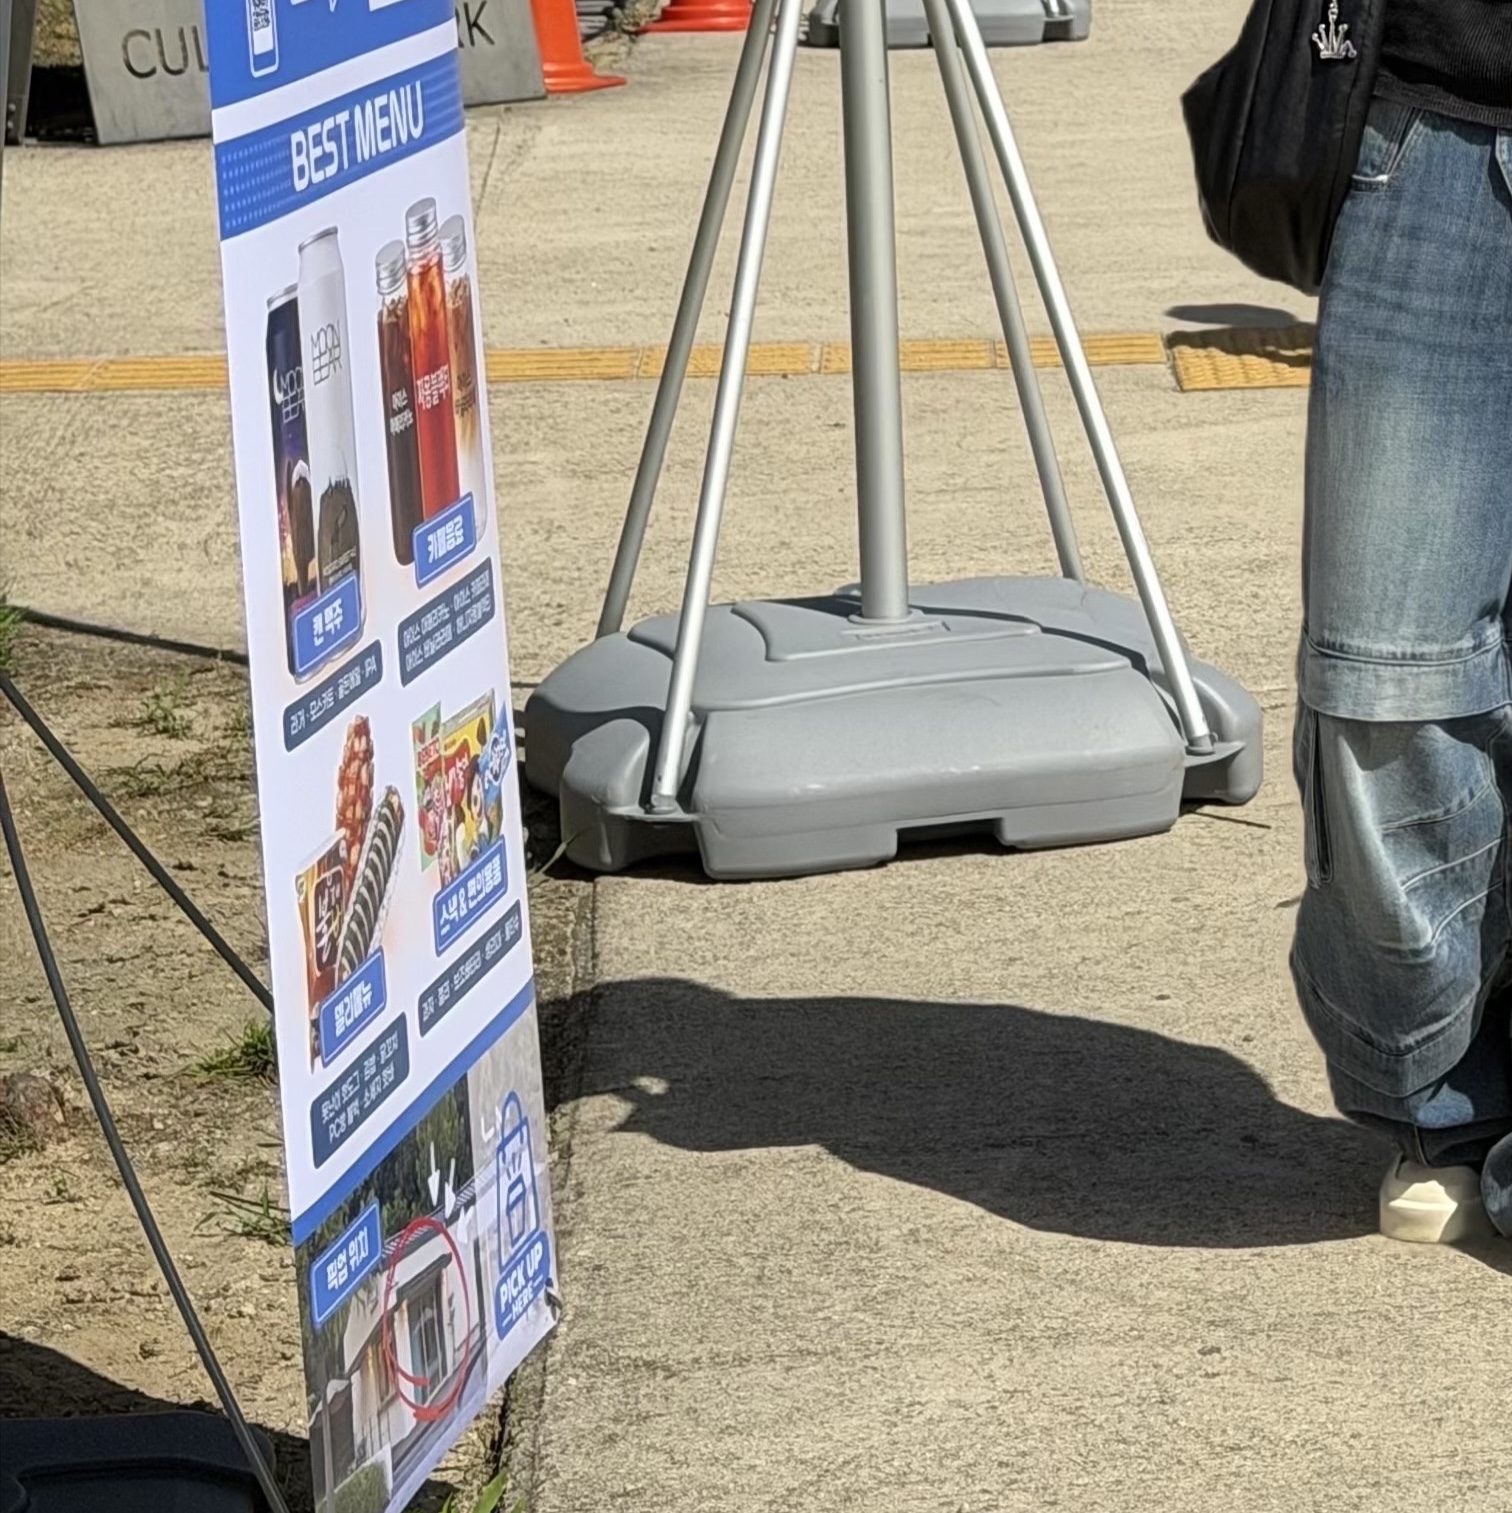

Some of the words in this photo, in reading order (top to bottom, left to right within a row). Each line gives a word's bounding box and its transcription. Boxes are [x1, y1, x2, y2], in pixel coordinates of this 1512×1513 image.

[290, 114, 349, 192] BEST
[353, 81, 425, 163] MENU
[426, 514, 465, 564] 카페음료
[324, 597, 344, 636] 맥주
[327, 1252, 348, 1292] 픽업
[349, 1226, 369, 1268] 위치
[500, 1263, 525, 1313] PICK
[526, 1240, 544, 1277] UP
[512, 1286, 534, 1322] HERE
